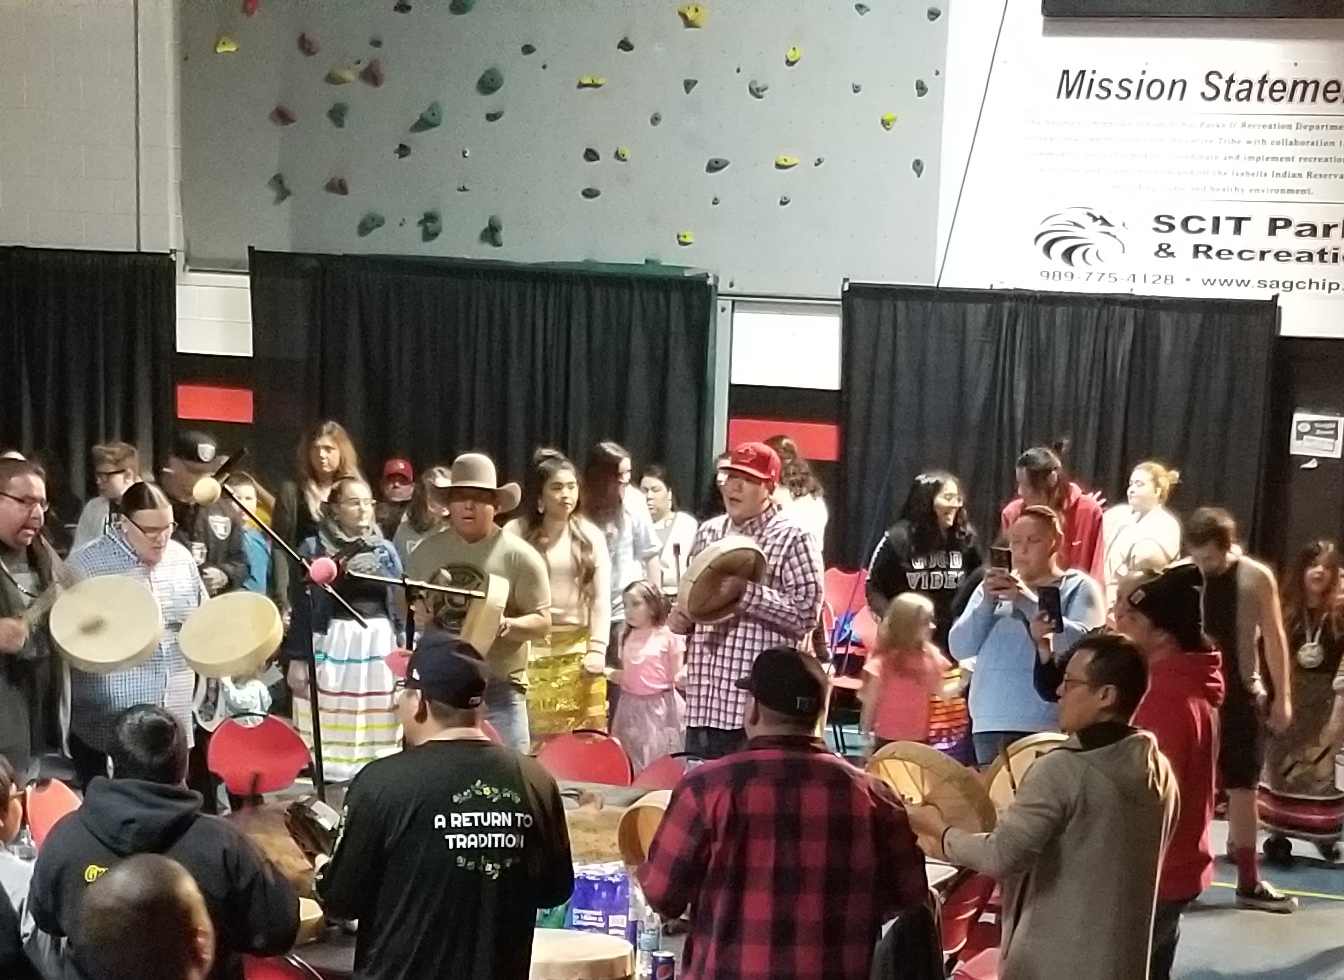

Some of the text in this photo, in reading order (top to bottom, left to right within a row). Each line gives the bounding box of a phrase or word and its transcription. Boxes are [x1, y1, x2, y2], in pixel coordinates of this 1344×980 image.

[1056, 69, 1187, 101] Mission
[1241, 122, 1292, 130] Recreation
[1218, 137, 1242, 145] Tribe
[1271, 138, 1335, 146] collaboration
[1244, 155, 1295, 163] implement
[1249, 188, 1314, 196] environment.
[1151, 214, 1252, 236] SCIT
[1153, 243, 1176, 259] &
[1040, 270, 1174, 286] 989-775-4128
[434, 811, 533, 829] A RETURN TO
[444, 833, 524, 849] TRADITION
